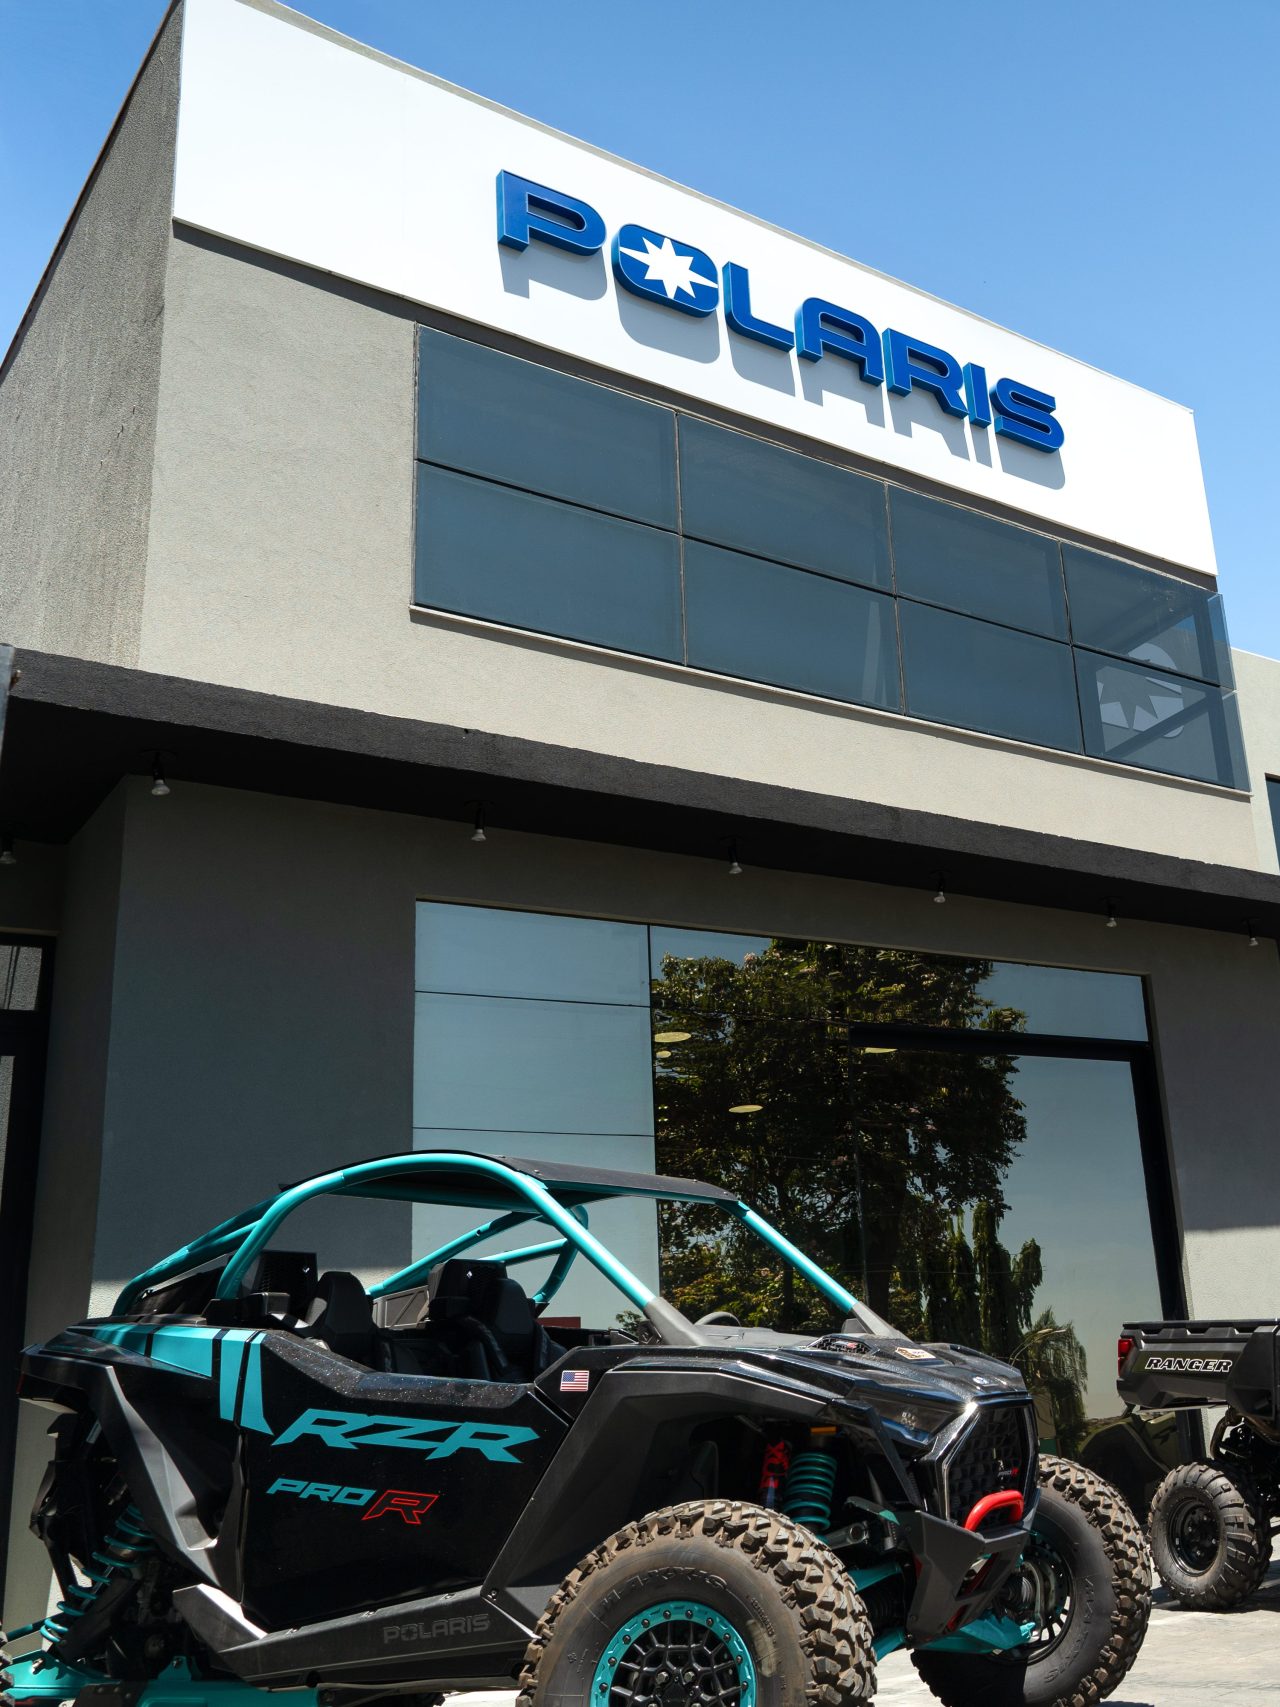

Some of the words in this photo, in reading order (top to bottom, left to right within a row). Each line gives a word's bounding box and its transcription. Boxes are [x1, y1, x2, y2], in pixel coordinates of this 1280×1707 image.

[496, 168, 1065, 454] POLARIS
[1144, 1357, 1233, 1373] RANGER
[270, 1408, 540, 1464] RZR
[382, 1613, 490, 1645] POLARIS
